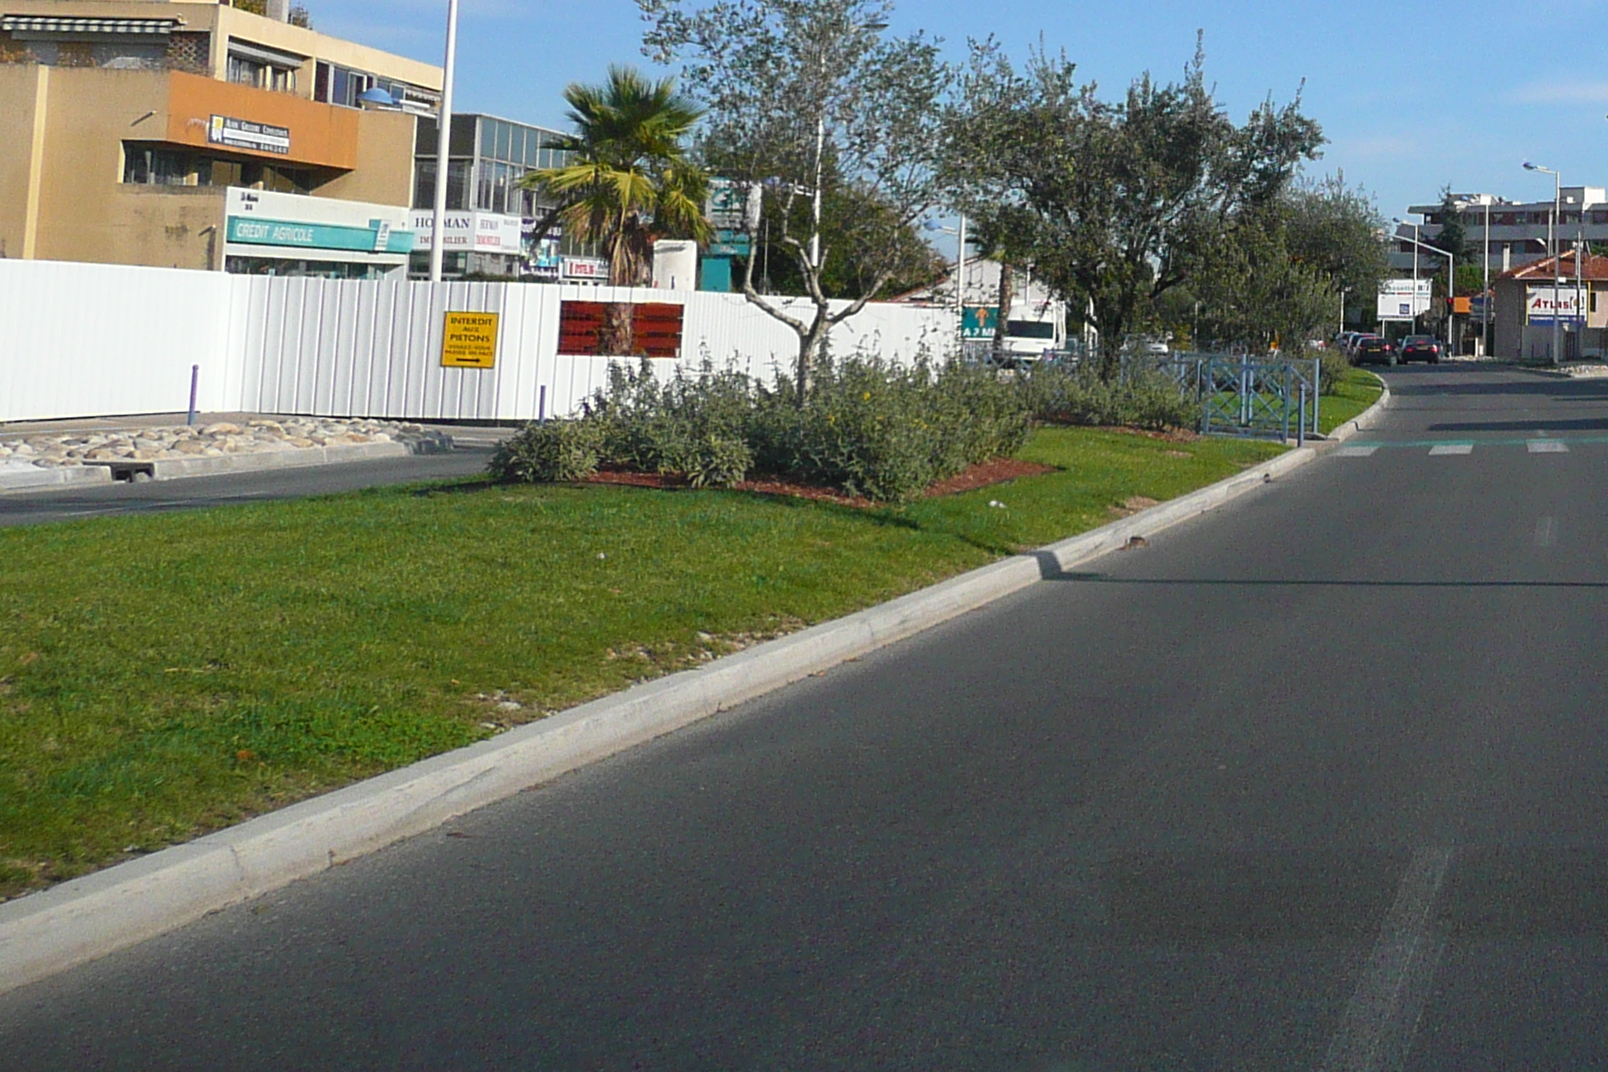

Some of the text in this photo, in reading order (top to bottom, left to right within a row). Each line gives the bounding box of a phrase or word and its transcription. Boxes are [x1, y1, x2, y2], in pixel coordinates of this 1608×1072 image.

[415, 217, 470, 228] HOMAN
[272, 226, 314, 242] AGRICOLE
[450, 317, 492, 326] INTERDIT
